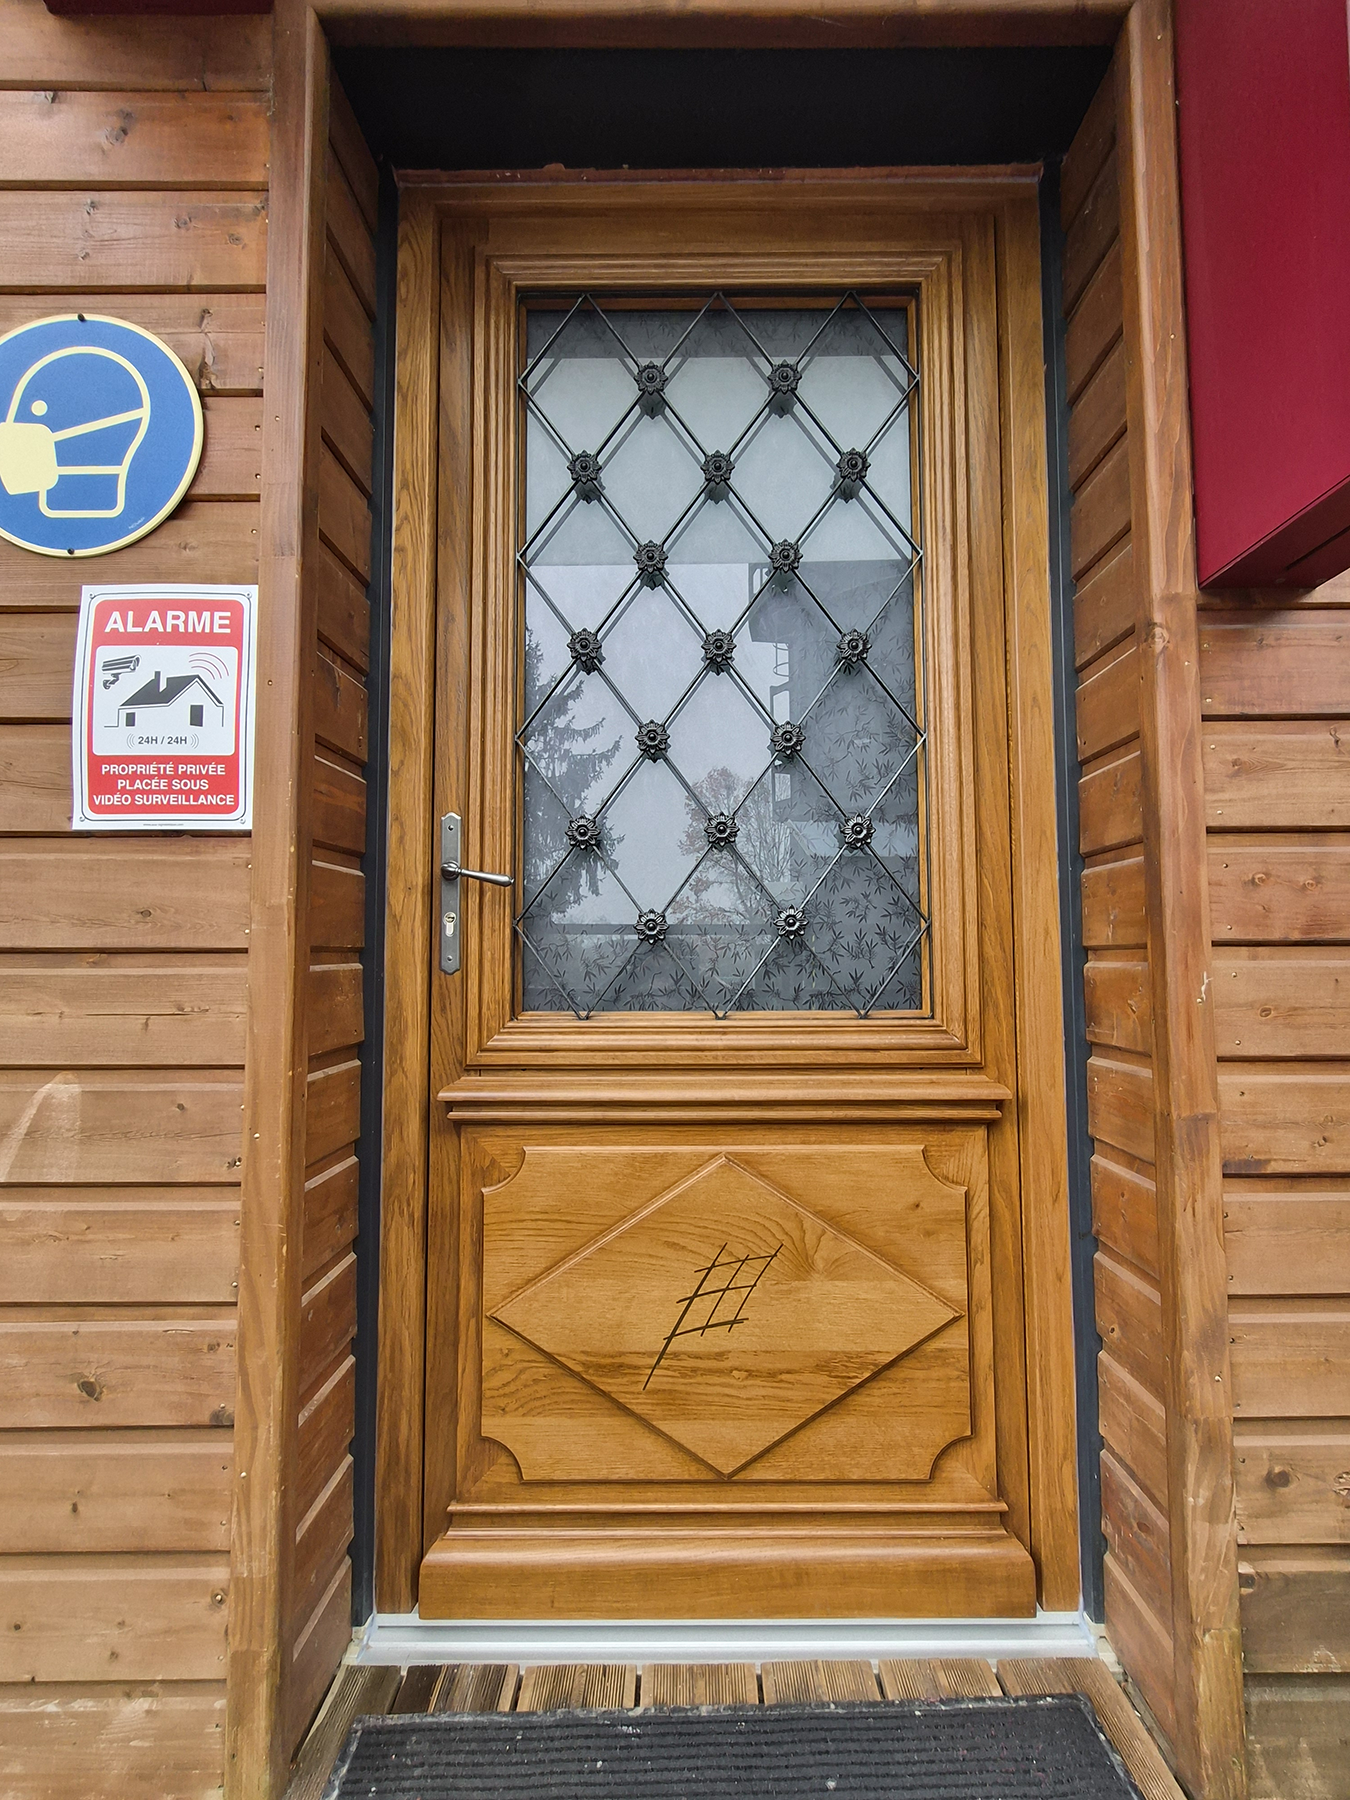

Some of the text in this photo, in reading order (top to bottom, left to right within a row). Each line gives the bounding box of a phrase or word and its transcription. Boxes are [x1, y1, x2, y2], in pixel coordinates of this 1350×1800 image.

[104, 610, 231, 633] ALARME
[138, 736, 158, 745] 24H
[167, 736, 187, 745] 24H
[101, 762, 226, 775] PROPRIÉTÉ PRIVÉE
[117, 777, 209, 790] PLACÉE SOUS
[93, 792, 235, 805] VIDÉO SURVEILLANCE
